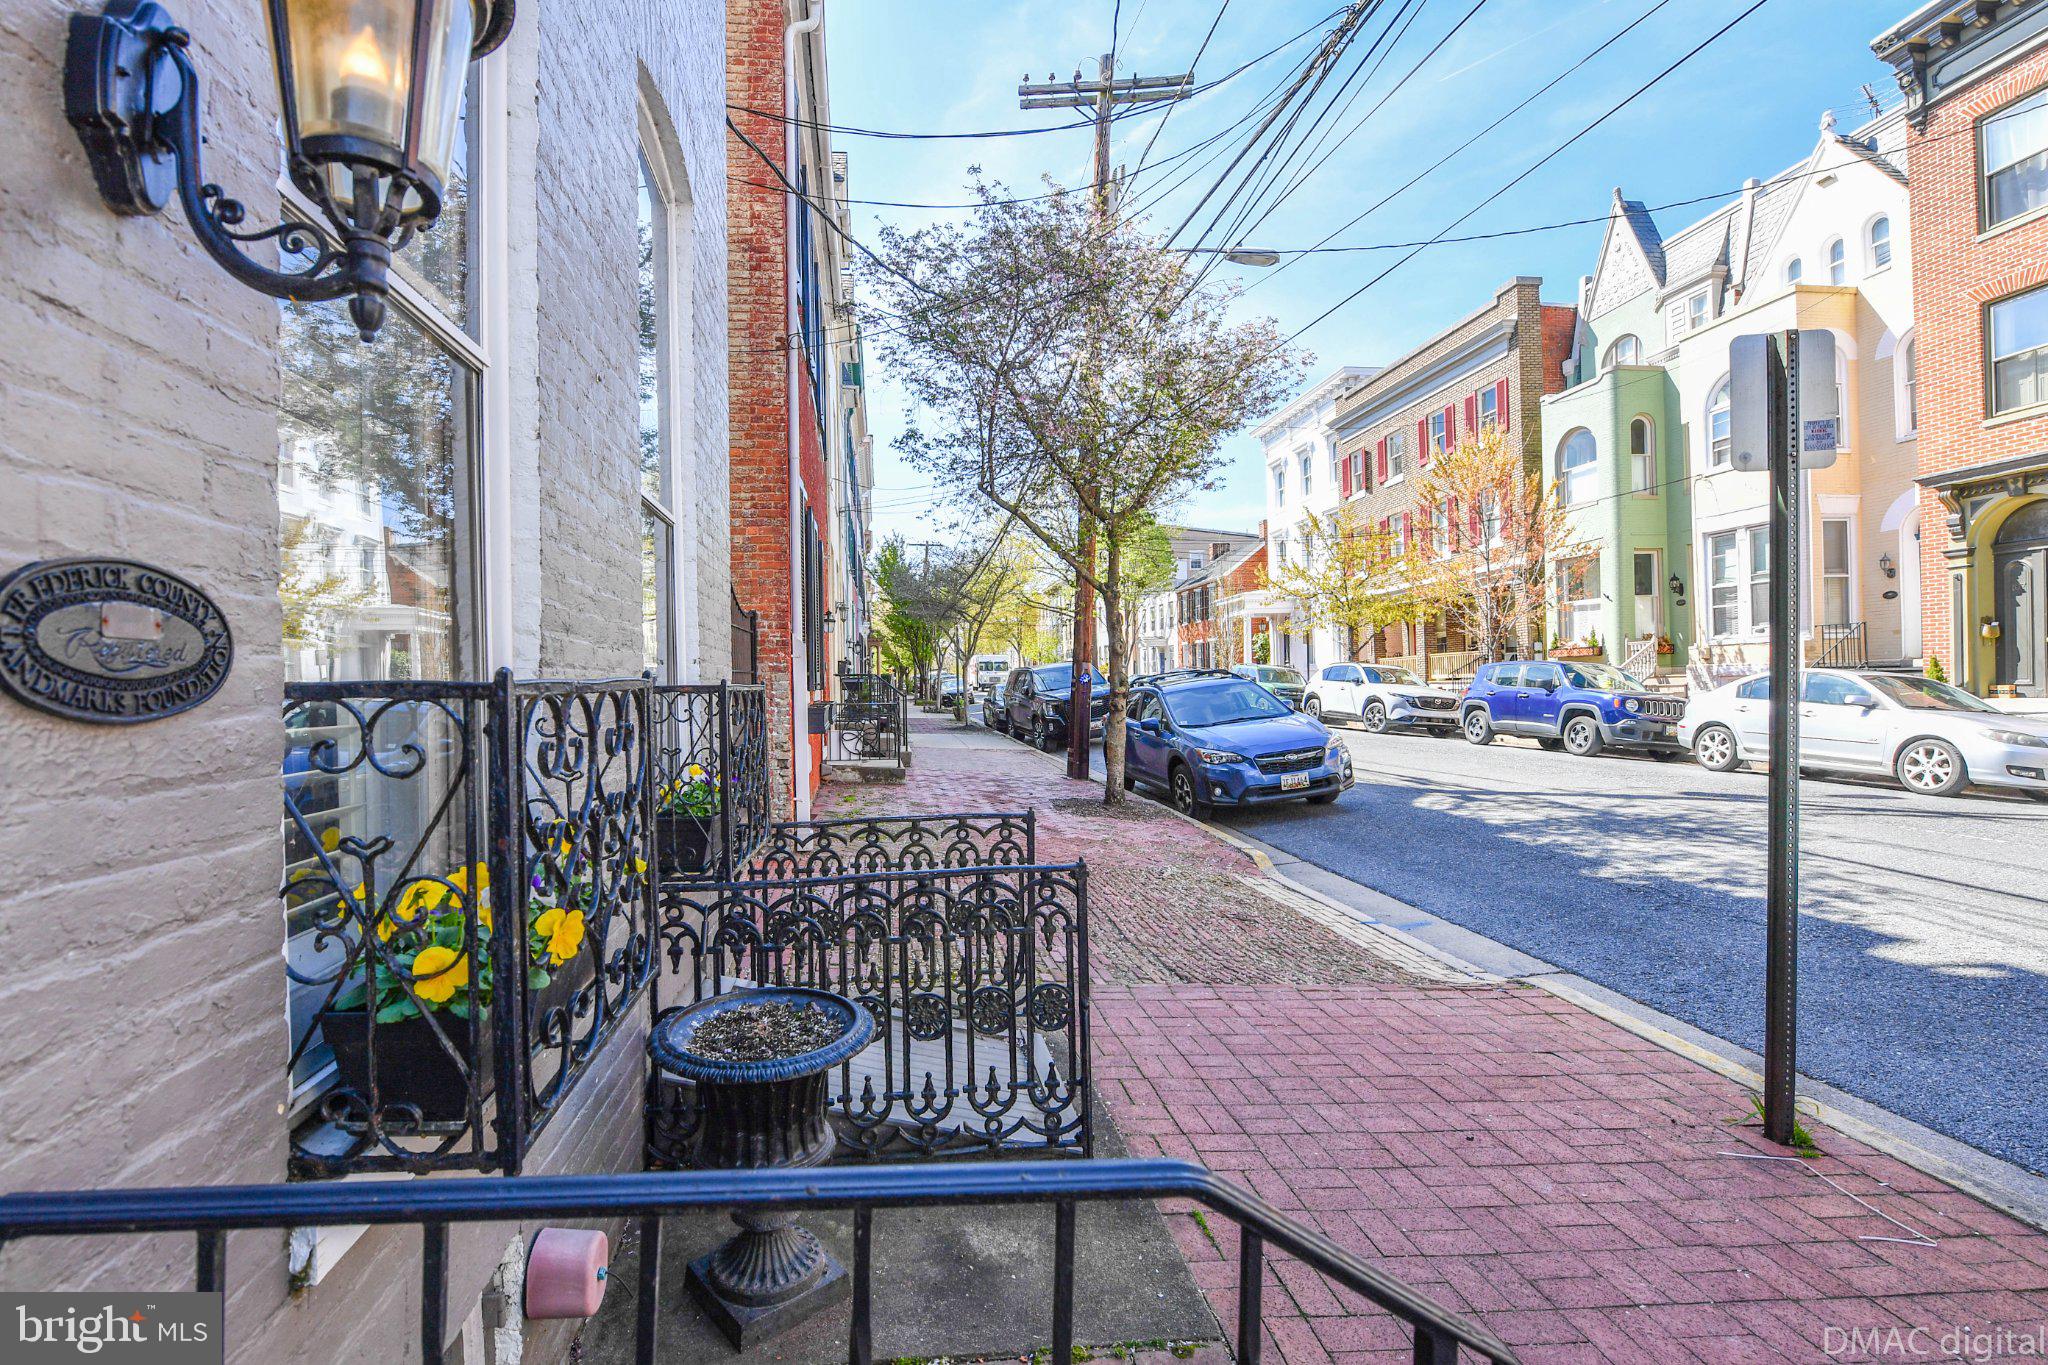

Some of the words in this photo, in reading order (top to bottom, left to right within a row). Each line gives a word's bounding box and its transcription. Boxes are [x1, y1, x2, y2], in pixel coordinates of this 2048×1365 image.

[2, 566, 130, 623] FREDERICK
[137, 573, 218, 622] COUNTY
[133, 631, 229, 714] FOUNDATION
